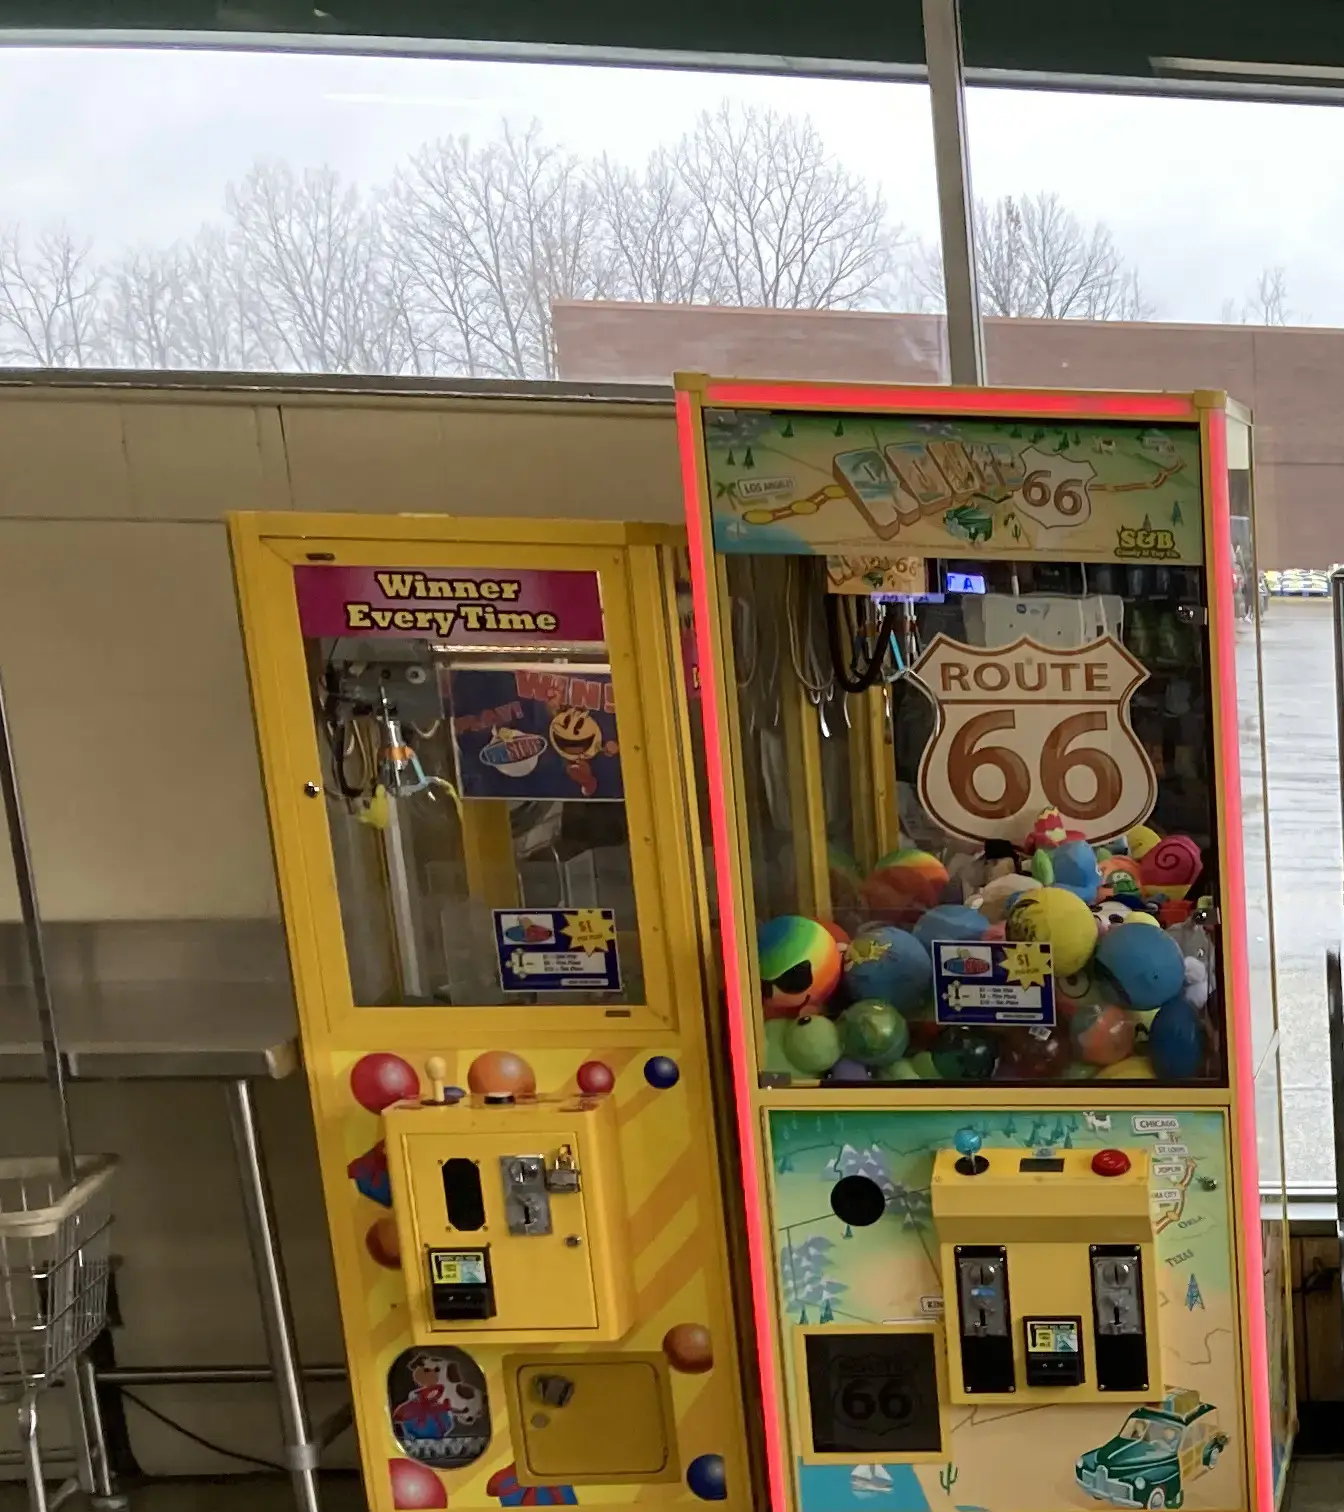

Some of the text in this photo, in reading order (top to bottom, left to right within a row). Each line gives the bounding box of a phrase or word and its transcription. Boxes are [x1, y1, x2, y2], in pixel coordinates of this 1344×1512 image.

[743, 482, 762, 495] LOS
[1022, 469, 1084, 516] 66
[1118, 529, 1175, 549] S&B
[376, 572, 521, 600] Winner
[346, 603, 558, 636] Every Time
[940, 662, 1112, 692] ROUTE
[947, 708, 1123, 821] 66
[1139, 1119, 1177, 1129] CHICAGO
[1163, 1191, 1178, 1200] CITY
[1164, 1248, 1195, 1268] TEXAS
[842, 1377, 913, 1420] 66
